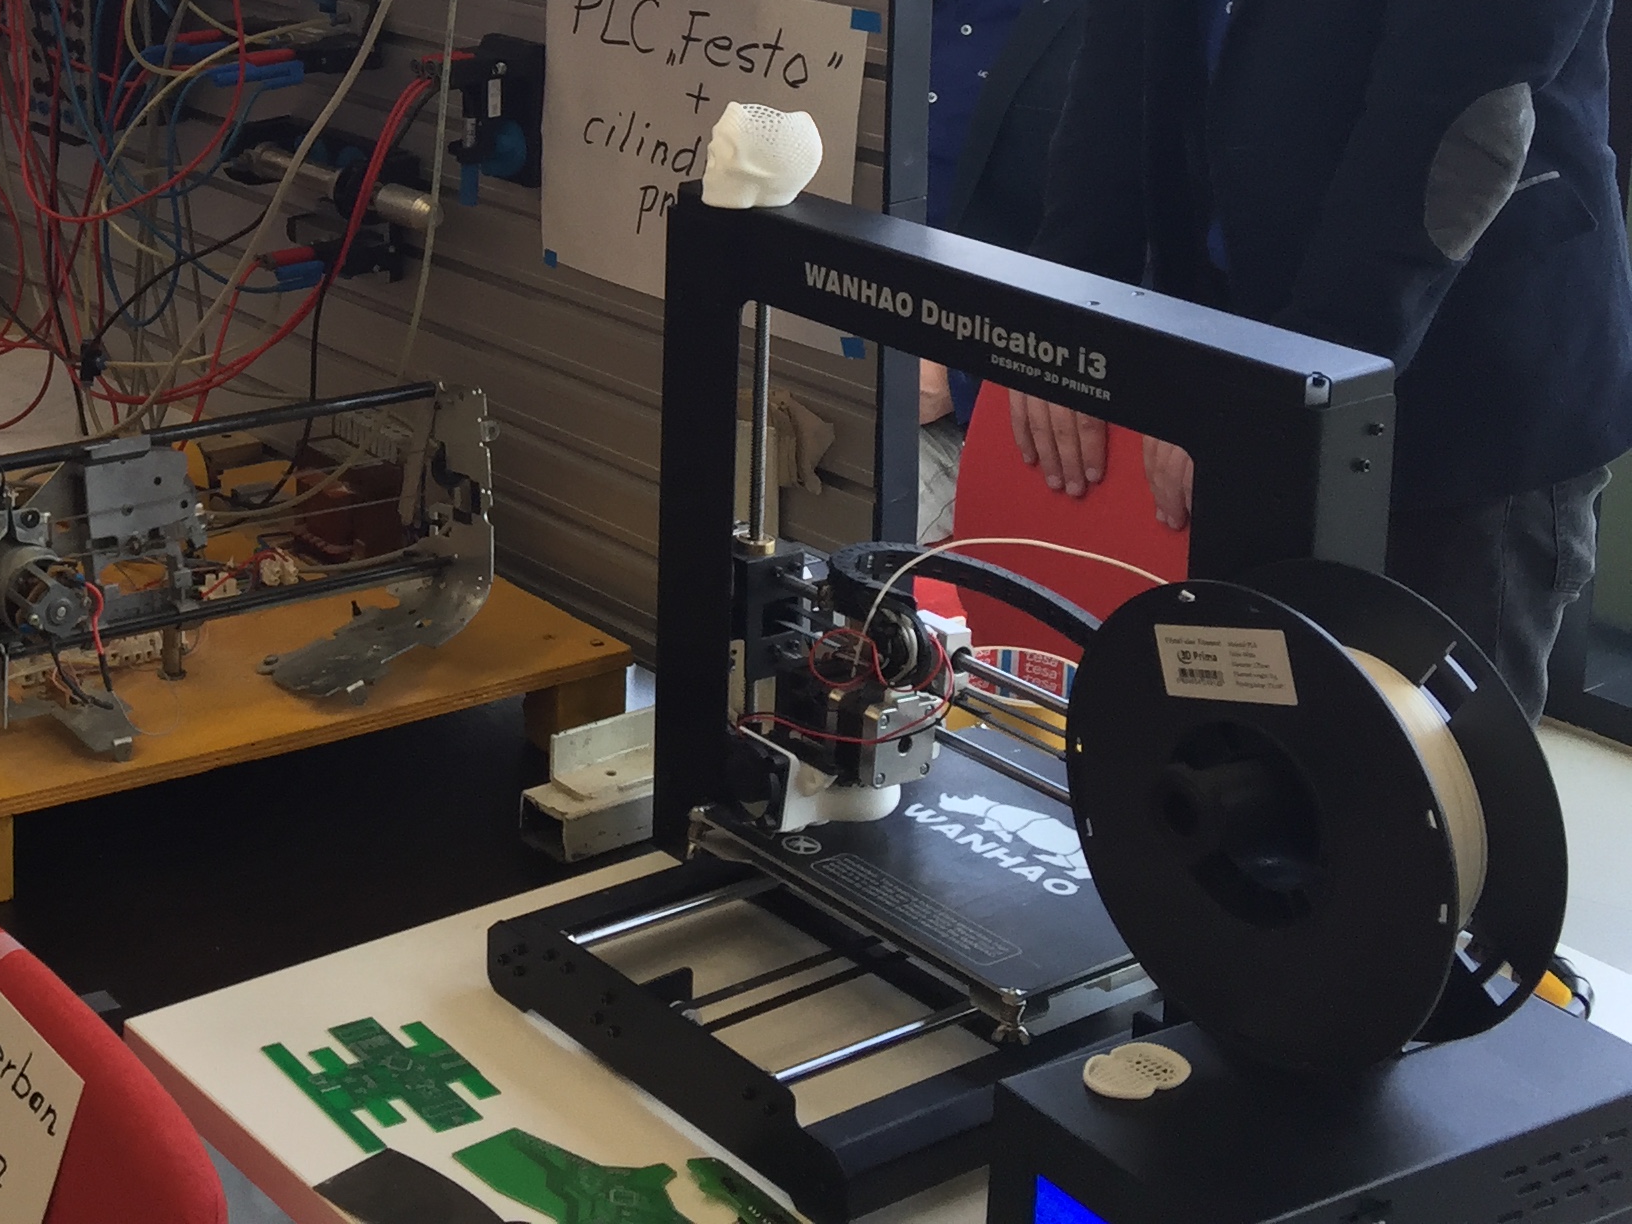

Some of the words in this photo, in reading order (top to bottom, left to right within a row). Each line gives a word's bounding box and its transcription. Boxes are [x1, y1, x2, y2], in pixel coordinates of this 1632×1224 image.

[804, 261, 915, 318] WANHAO
[921, 298, 1070, 367] Duplicator
[1076, 346, 1108, 380] i3
[990, 353, 1042, 379] DESKTOP
[1043, 367, 1060, 385] 3D
[1061, 376, 1112, 402] PRINTER
[1025, 662, 1058, 679] tesa
[1026, 651, 1059, 667] tesa
[904, 802, 1080, 896] WANHAO
